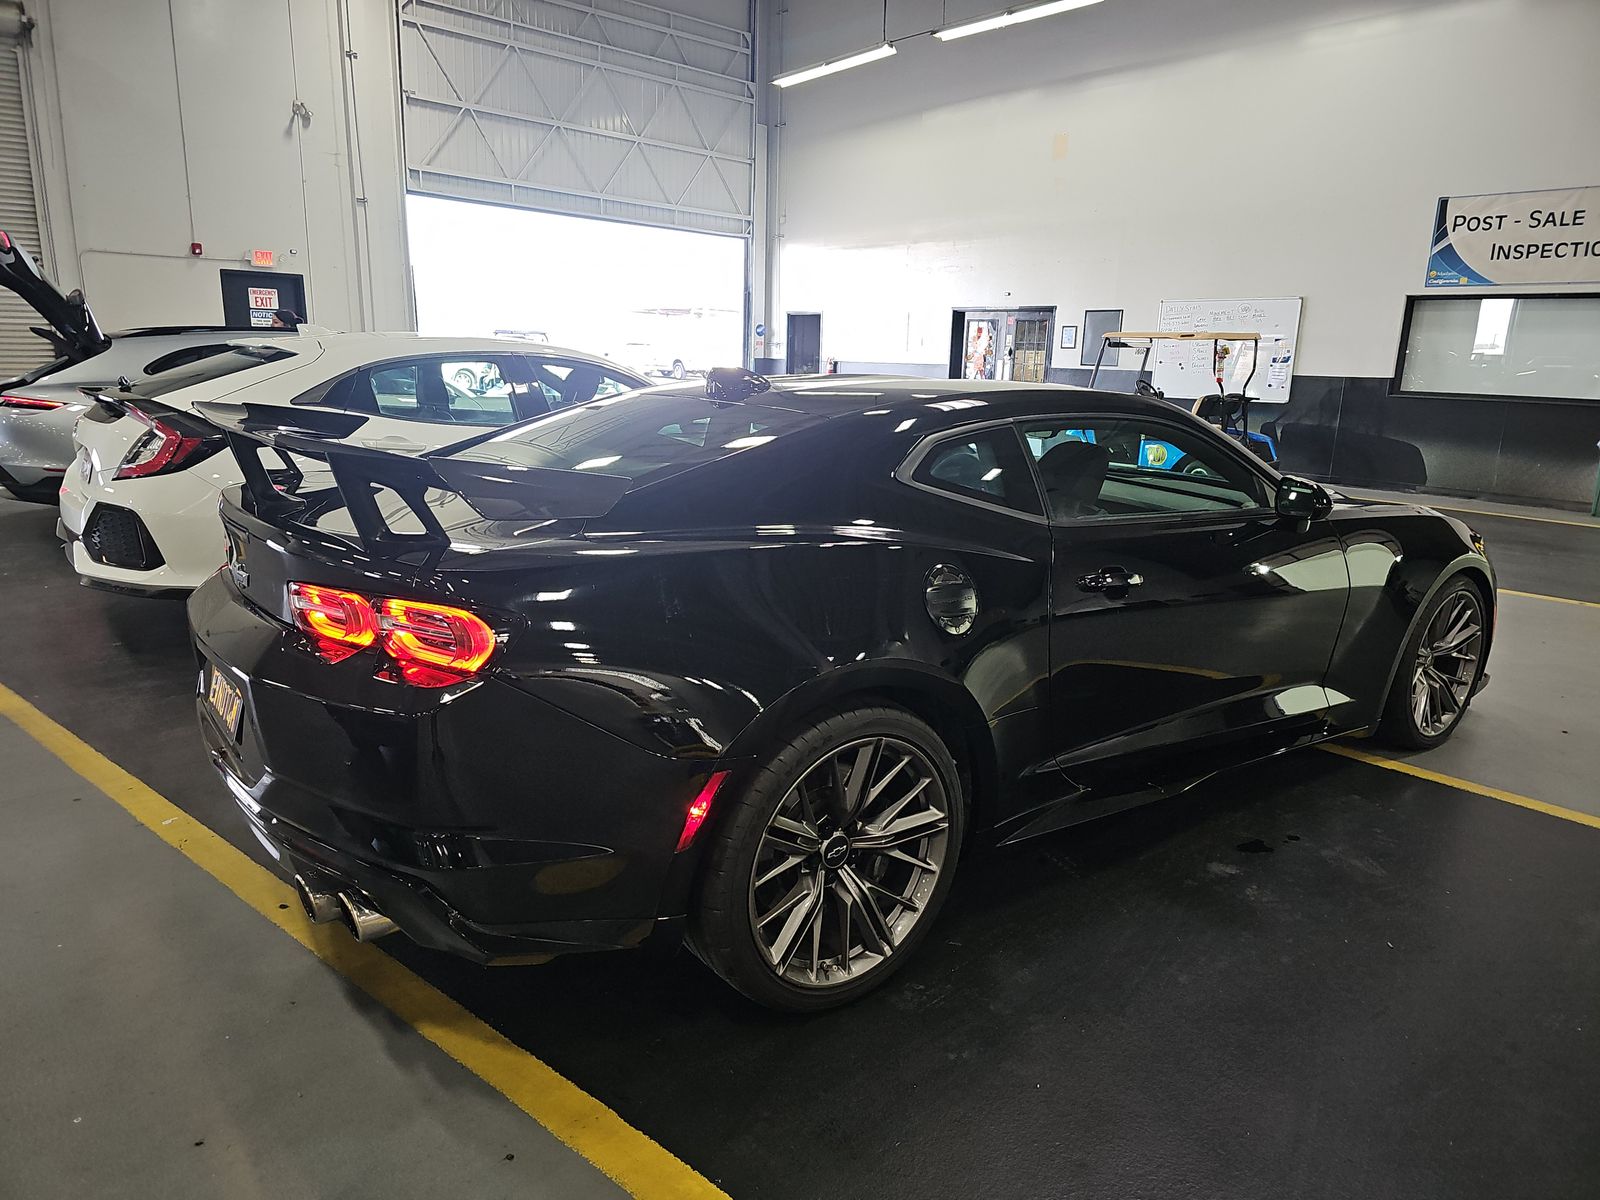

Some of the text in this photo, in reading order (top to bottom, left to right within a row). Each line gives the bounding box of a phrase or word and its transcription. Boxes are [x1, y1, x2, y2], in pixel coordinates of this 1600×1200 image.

[1452, 215, 1508, 232] POST
[1528, 210, 1586, 228] SALE
[249, 289, 277, 297] EMERGENCY
[254, 296, 273, 308] EXIT
